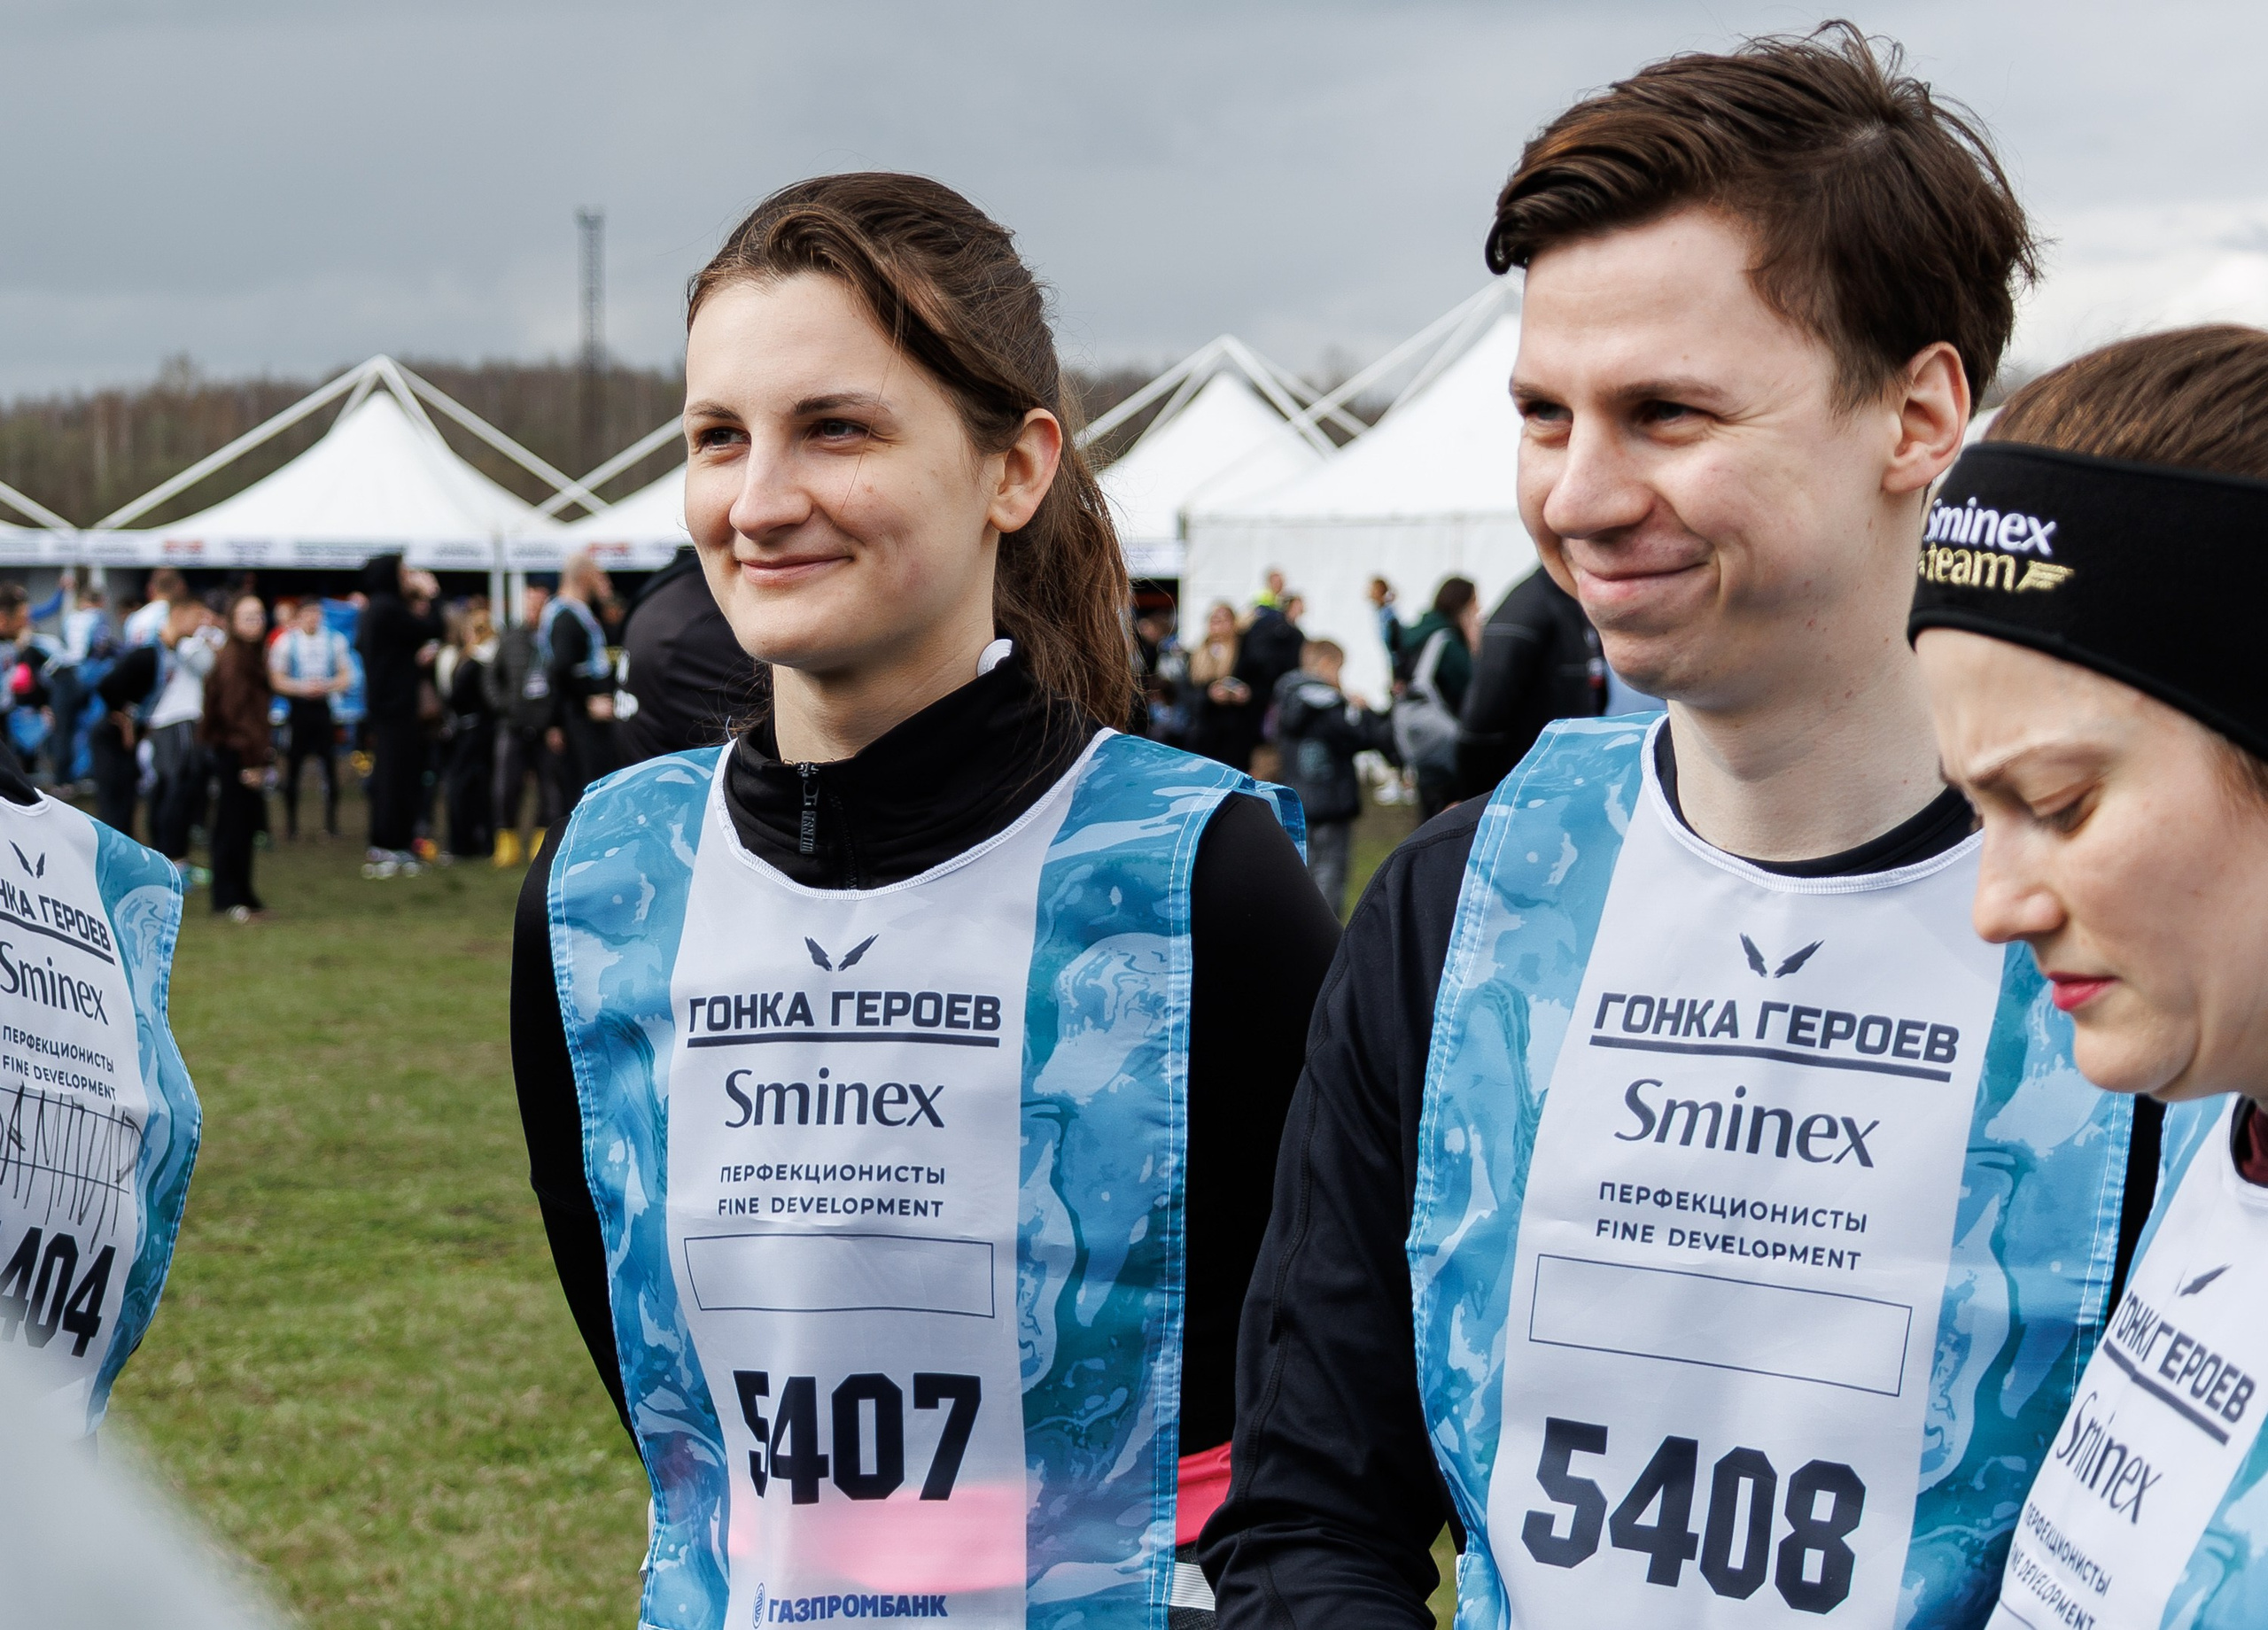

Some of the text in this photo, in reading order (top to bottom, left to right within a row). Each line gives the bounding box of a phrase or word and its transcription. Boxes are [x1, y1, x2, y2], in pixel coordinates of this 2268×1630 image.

[1925, 542, 2016, 593] team
[38, 894, 112, 952] ГЕРОЕВ
[0, 941, 109, 1026] Sminex
[689, 990, 1001, 1033] ГОНКА ГЕРОЕВ
[4, 1025, 114, 1075] ПЕРФЕКЦИОНИСТЫ
[1594, 992, 1960, 1064] ГОНКА ГЕРОЕВ
[4, 1055, 116, 1102] FINE DEVELOPMENT
[725, 1067, 945, 1129] Sminex
[1613, 1077, 1882, 1168] Sminex
[720, 1164, 945, 1185] ПЕРФЕКЦИОНИСТЫ
[718, 1197, 944, 1218] FINE DEVELOPMENT
[1598, 1181, 1868, 1234] ПЕРФЕКЦИОНИСТЫ
[1596, 1219, 1862, 1271] FINE DEVELOPMENT
[0, 1220, 116, 1358] 404
[2141, 1320, 2256, 1424] ГЕРОЕВ
[733, 1370, 983, 1505] 5407
[2056, 1391, 2163, 1525] Sminex
[1521, 1417, 1867, 1615] 5408
[767, 1594, 949, 1623] ГАЗПРОМБАНК
